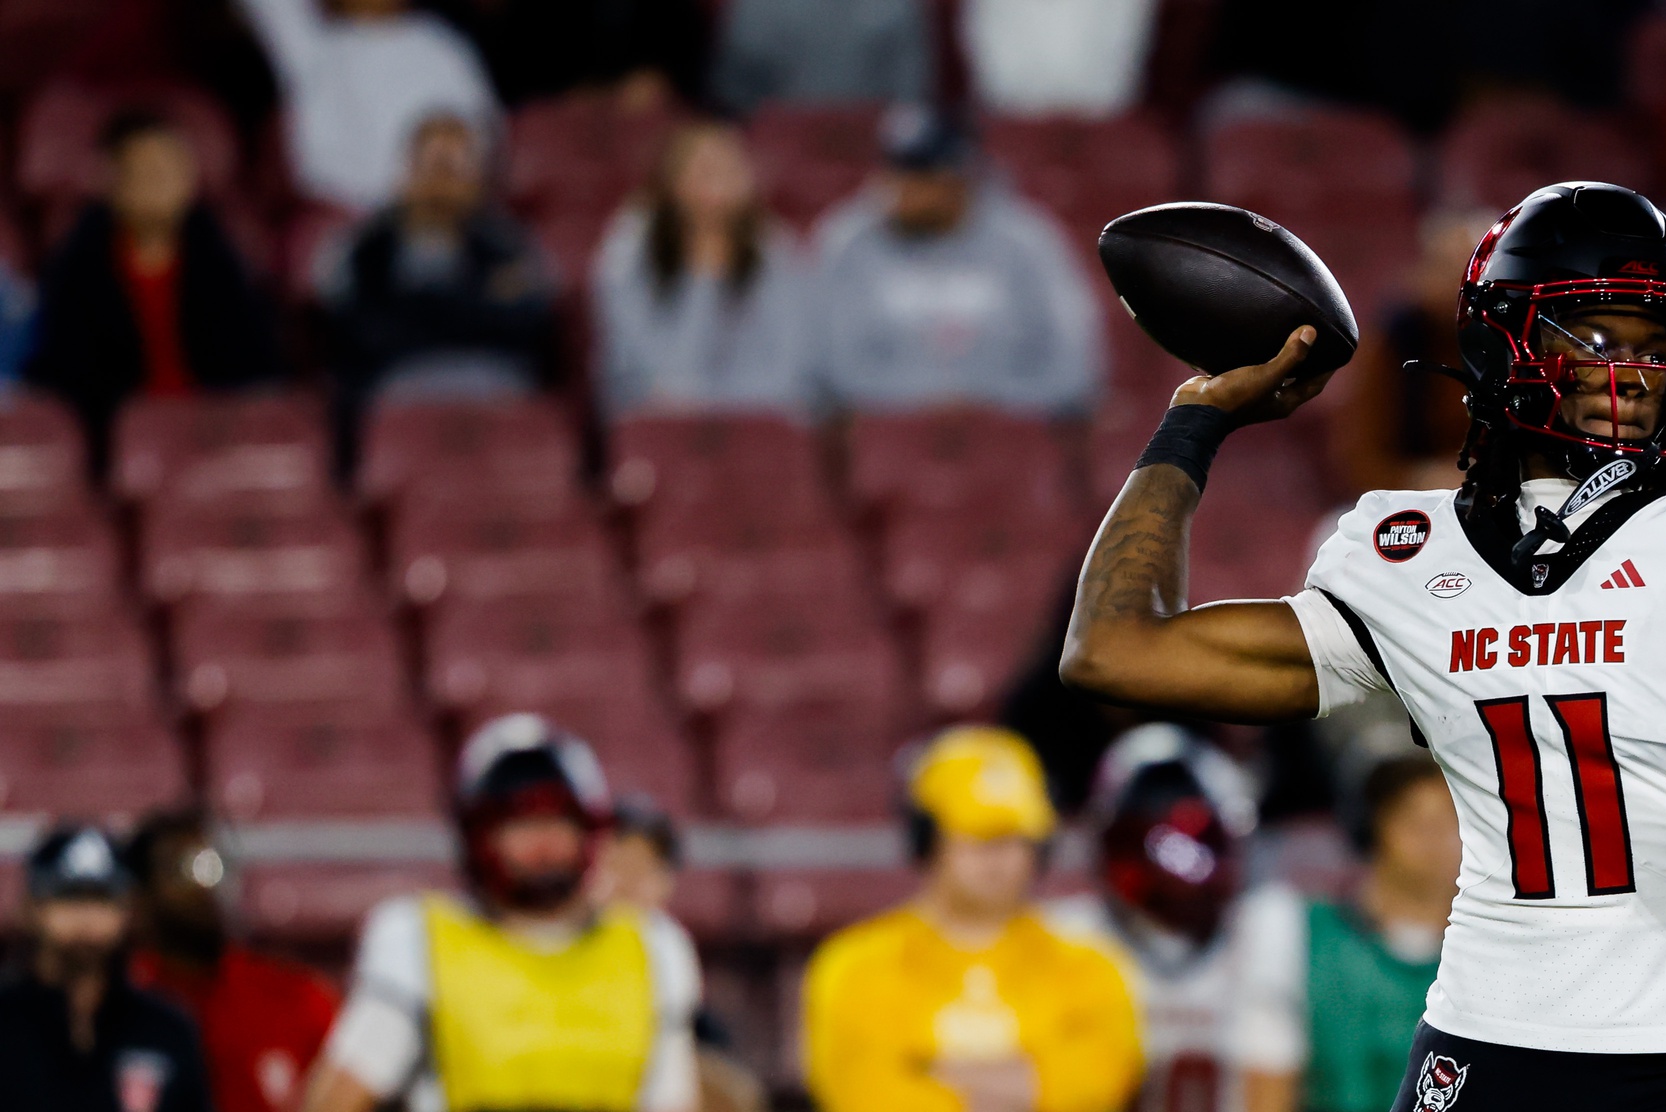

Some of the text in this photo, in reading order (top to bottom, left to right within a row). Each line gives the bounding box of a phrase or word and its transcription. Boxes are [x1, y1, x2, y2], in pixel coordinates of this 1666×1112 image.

[1618, 260, 1659, 273] ACC
[1569, 462, 1630, 512] BATTLE
[1390, 525, 1417, 534] PAYTON
[1379, 531, 1426, 547] WILSON
[1432, 578, 1466, 589] ACC
[1449, 620, 1627, 673] NC STATE
[1474, 692, 1637, 899] 11
